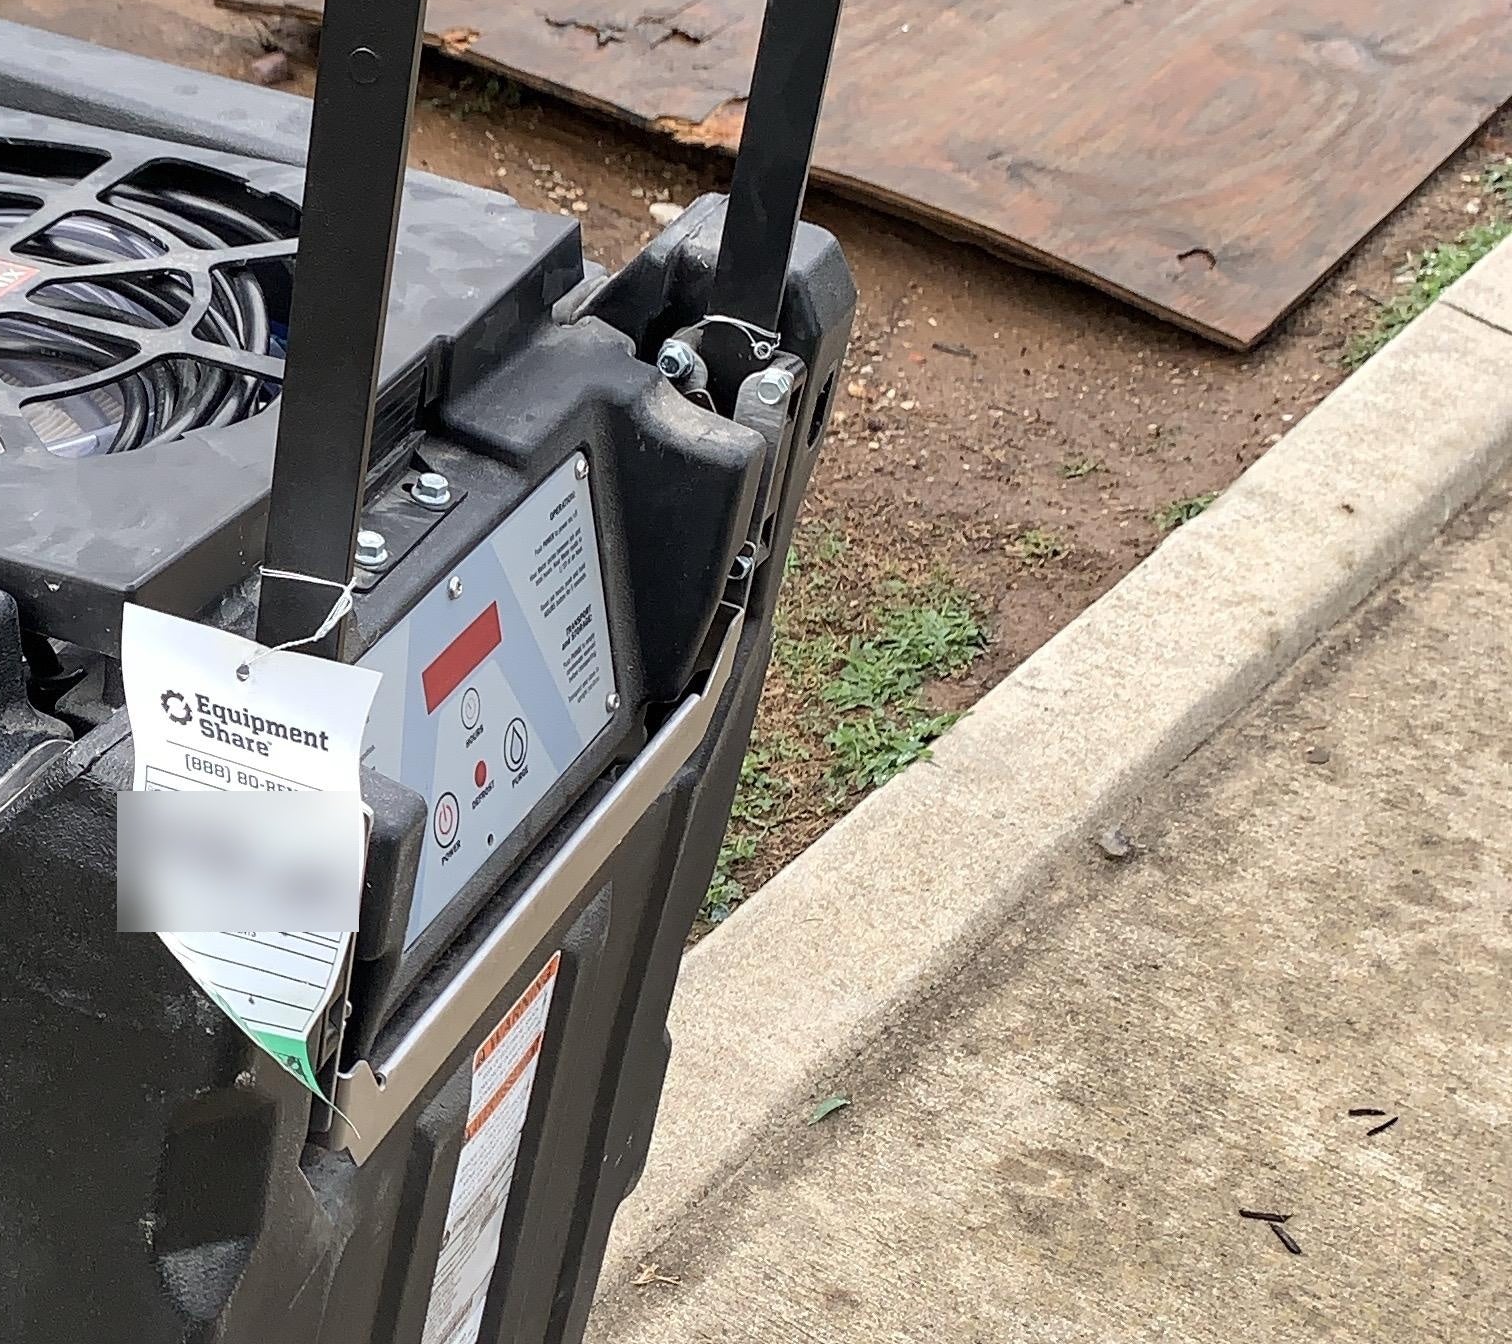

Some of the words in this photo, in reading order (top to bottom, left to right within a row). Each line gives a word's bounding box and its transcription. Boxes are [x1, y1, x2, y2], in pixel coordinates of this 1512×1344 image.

[194, 691, 329, 752] Equipment
[200, 717, 270, 757] Share
[184, 754, 232, 784] (888)
